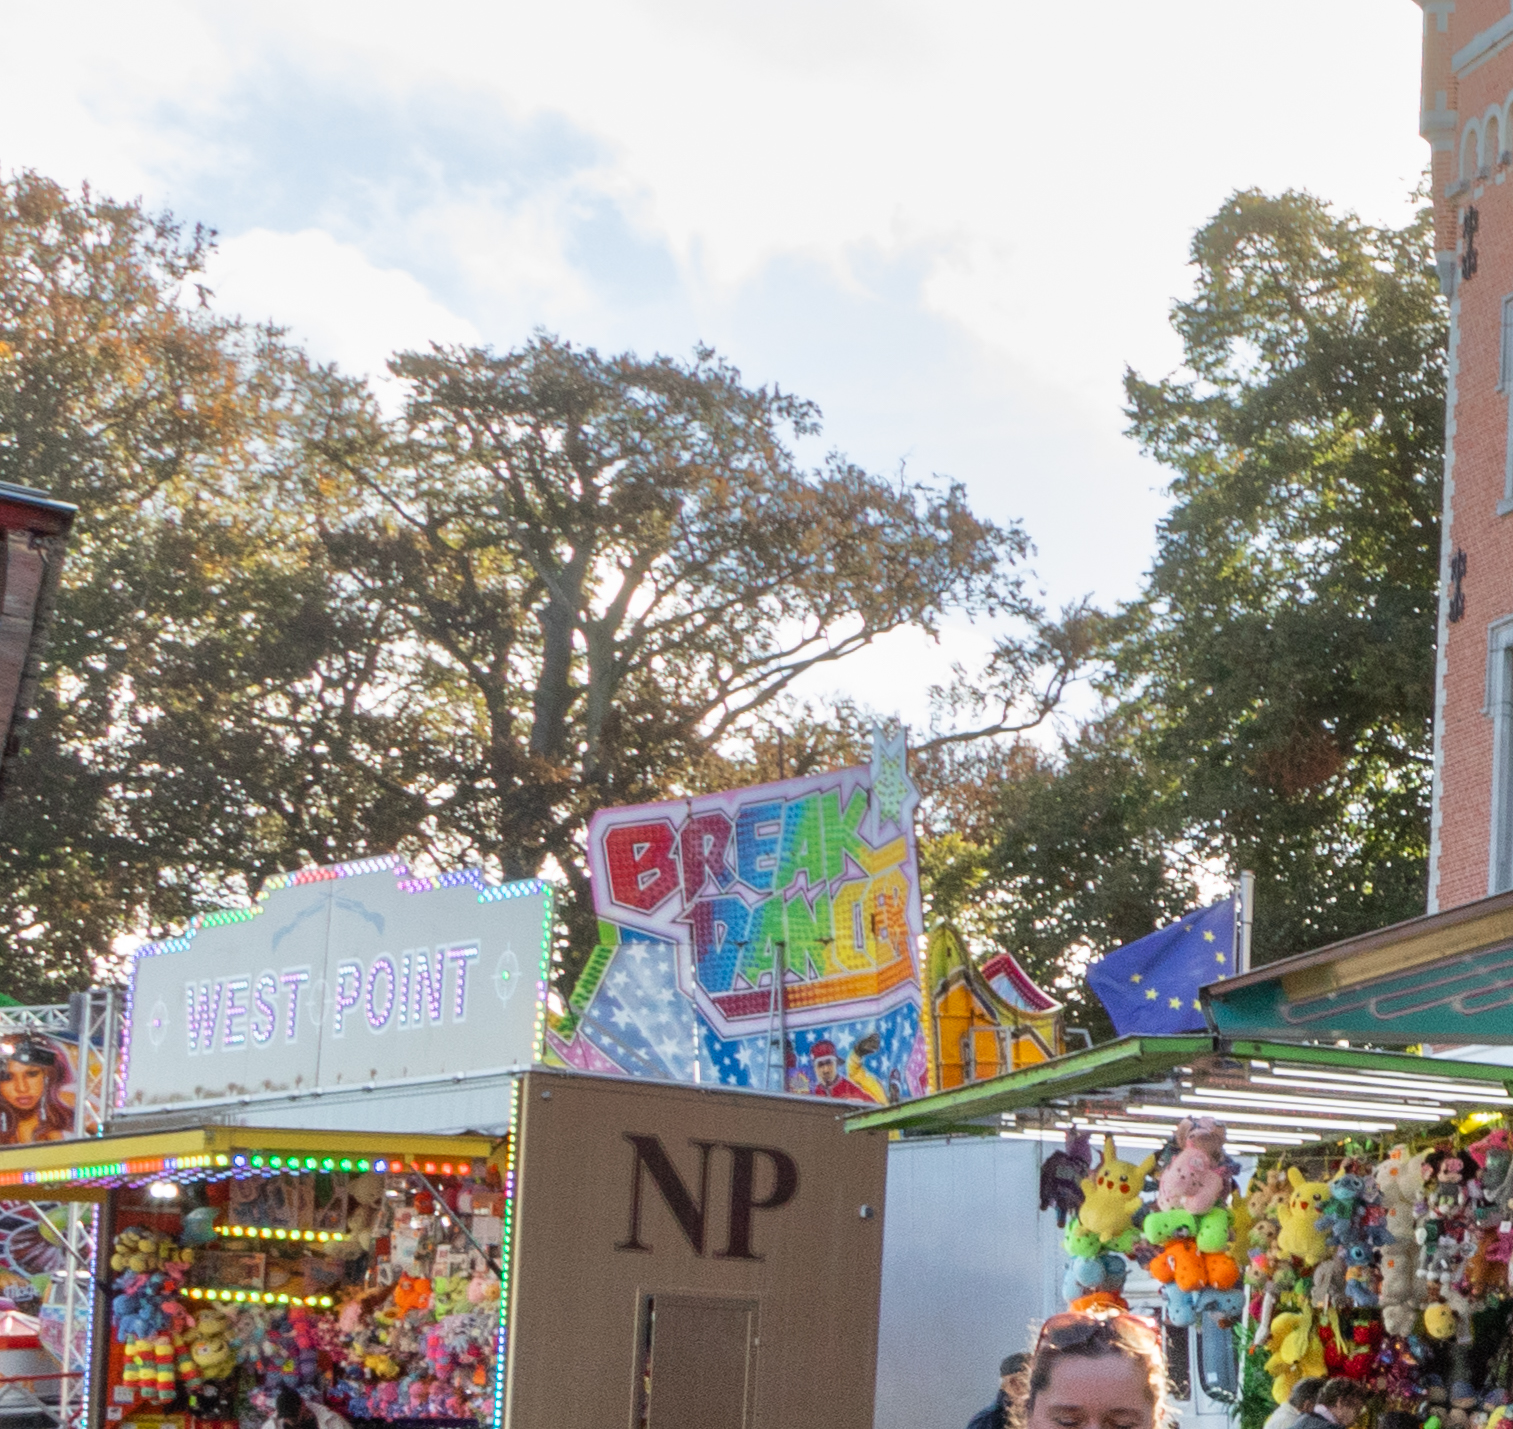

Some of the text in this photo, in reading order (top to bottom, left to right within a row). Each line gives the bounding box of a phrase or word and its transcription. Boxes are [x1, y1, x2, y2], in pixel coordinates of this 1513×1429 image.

[603, 783, 906, 916] BREAK
[185, 938, 481, 1056] WEST POINT
[614, 1131, 799, 1263] NP
